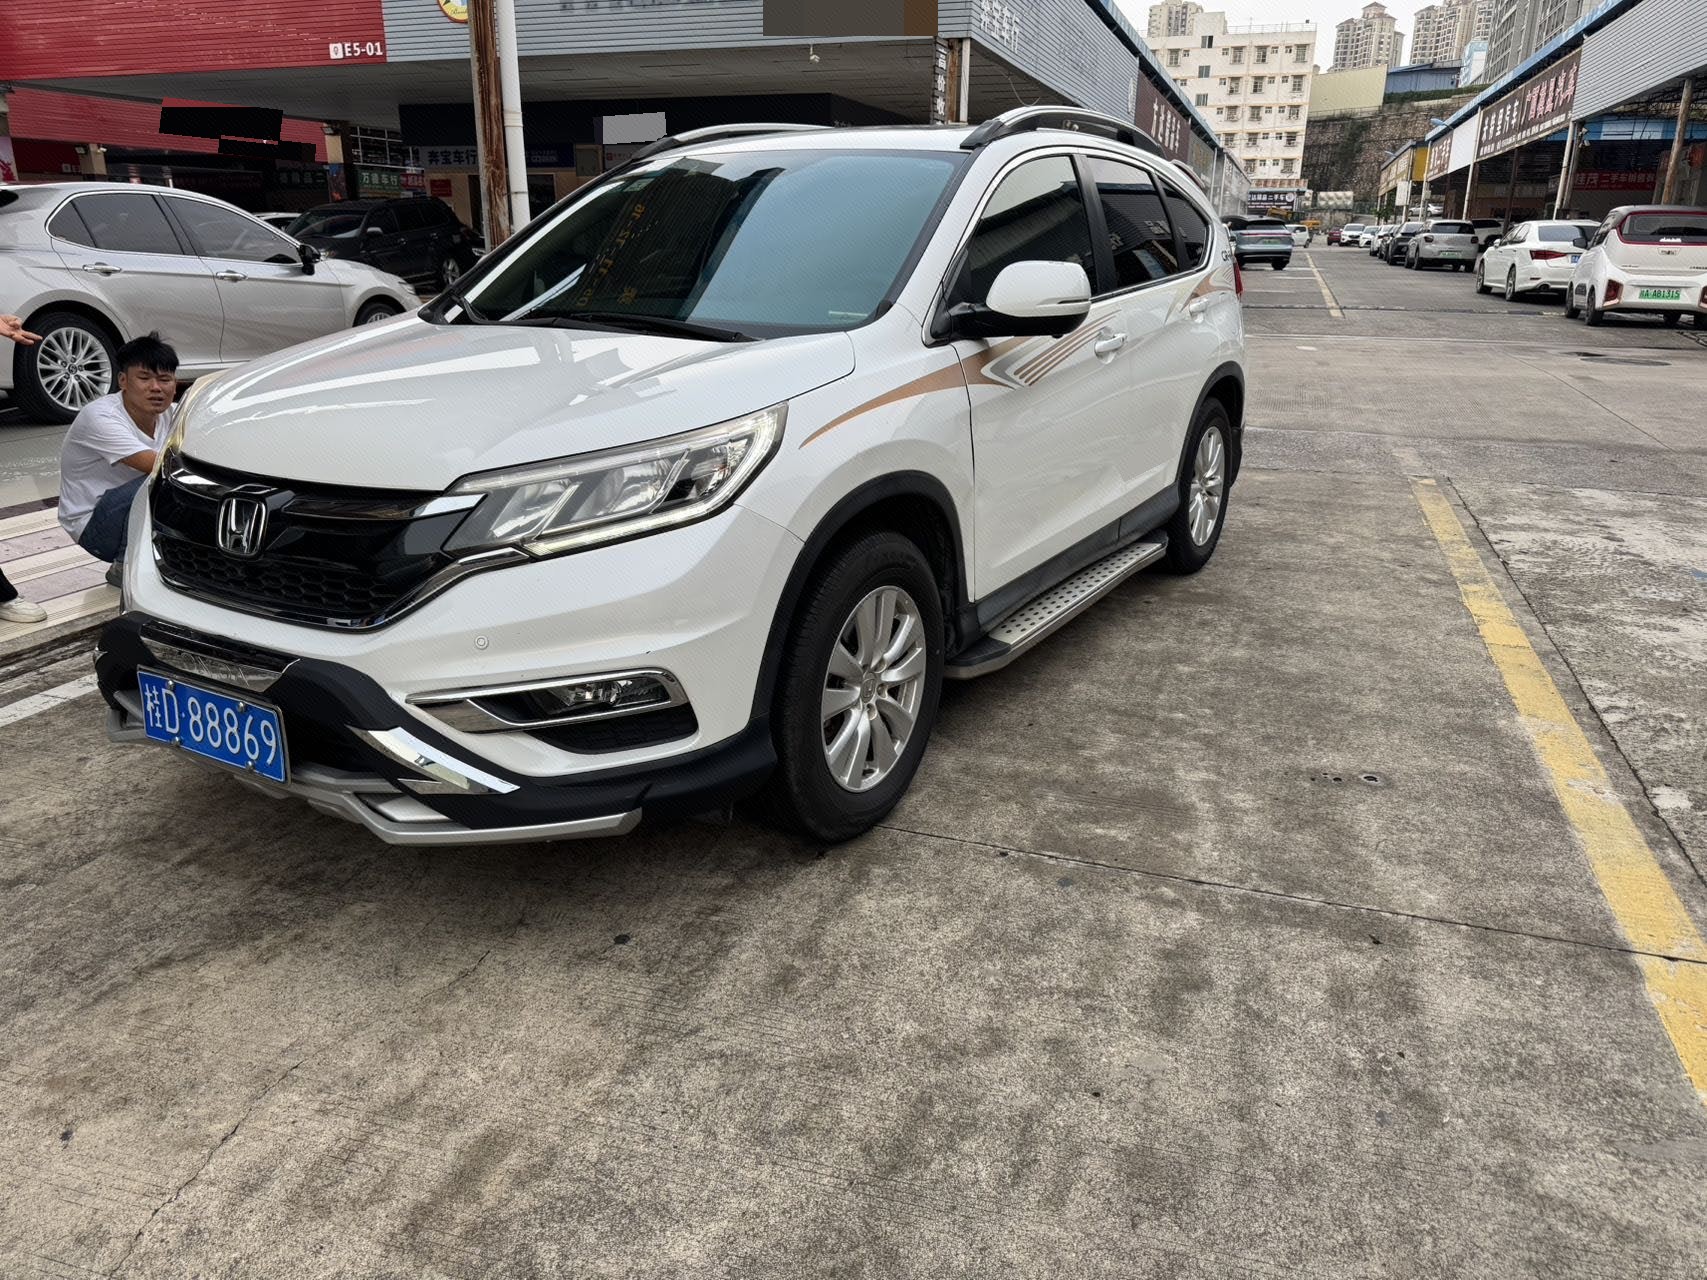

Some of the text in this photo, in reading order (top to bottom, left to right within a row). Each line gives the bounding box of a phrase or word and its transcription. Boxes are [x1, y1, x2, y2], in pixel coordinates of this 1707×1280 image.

[344, 42, 383, 56] E5-01
[936, 48, 948, 126] 高价收
[428, 150, 477, 165] 奔宝车行
